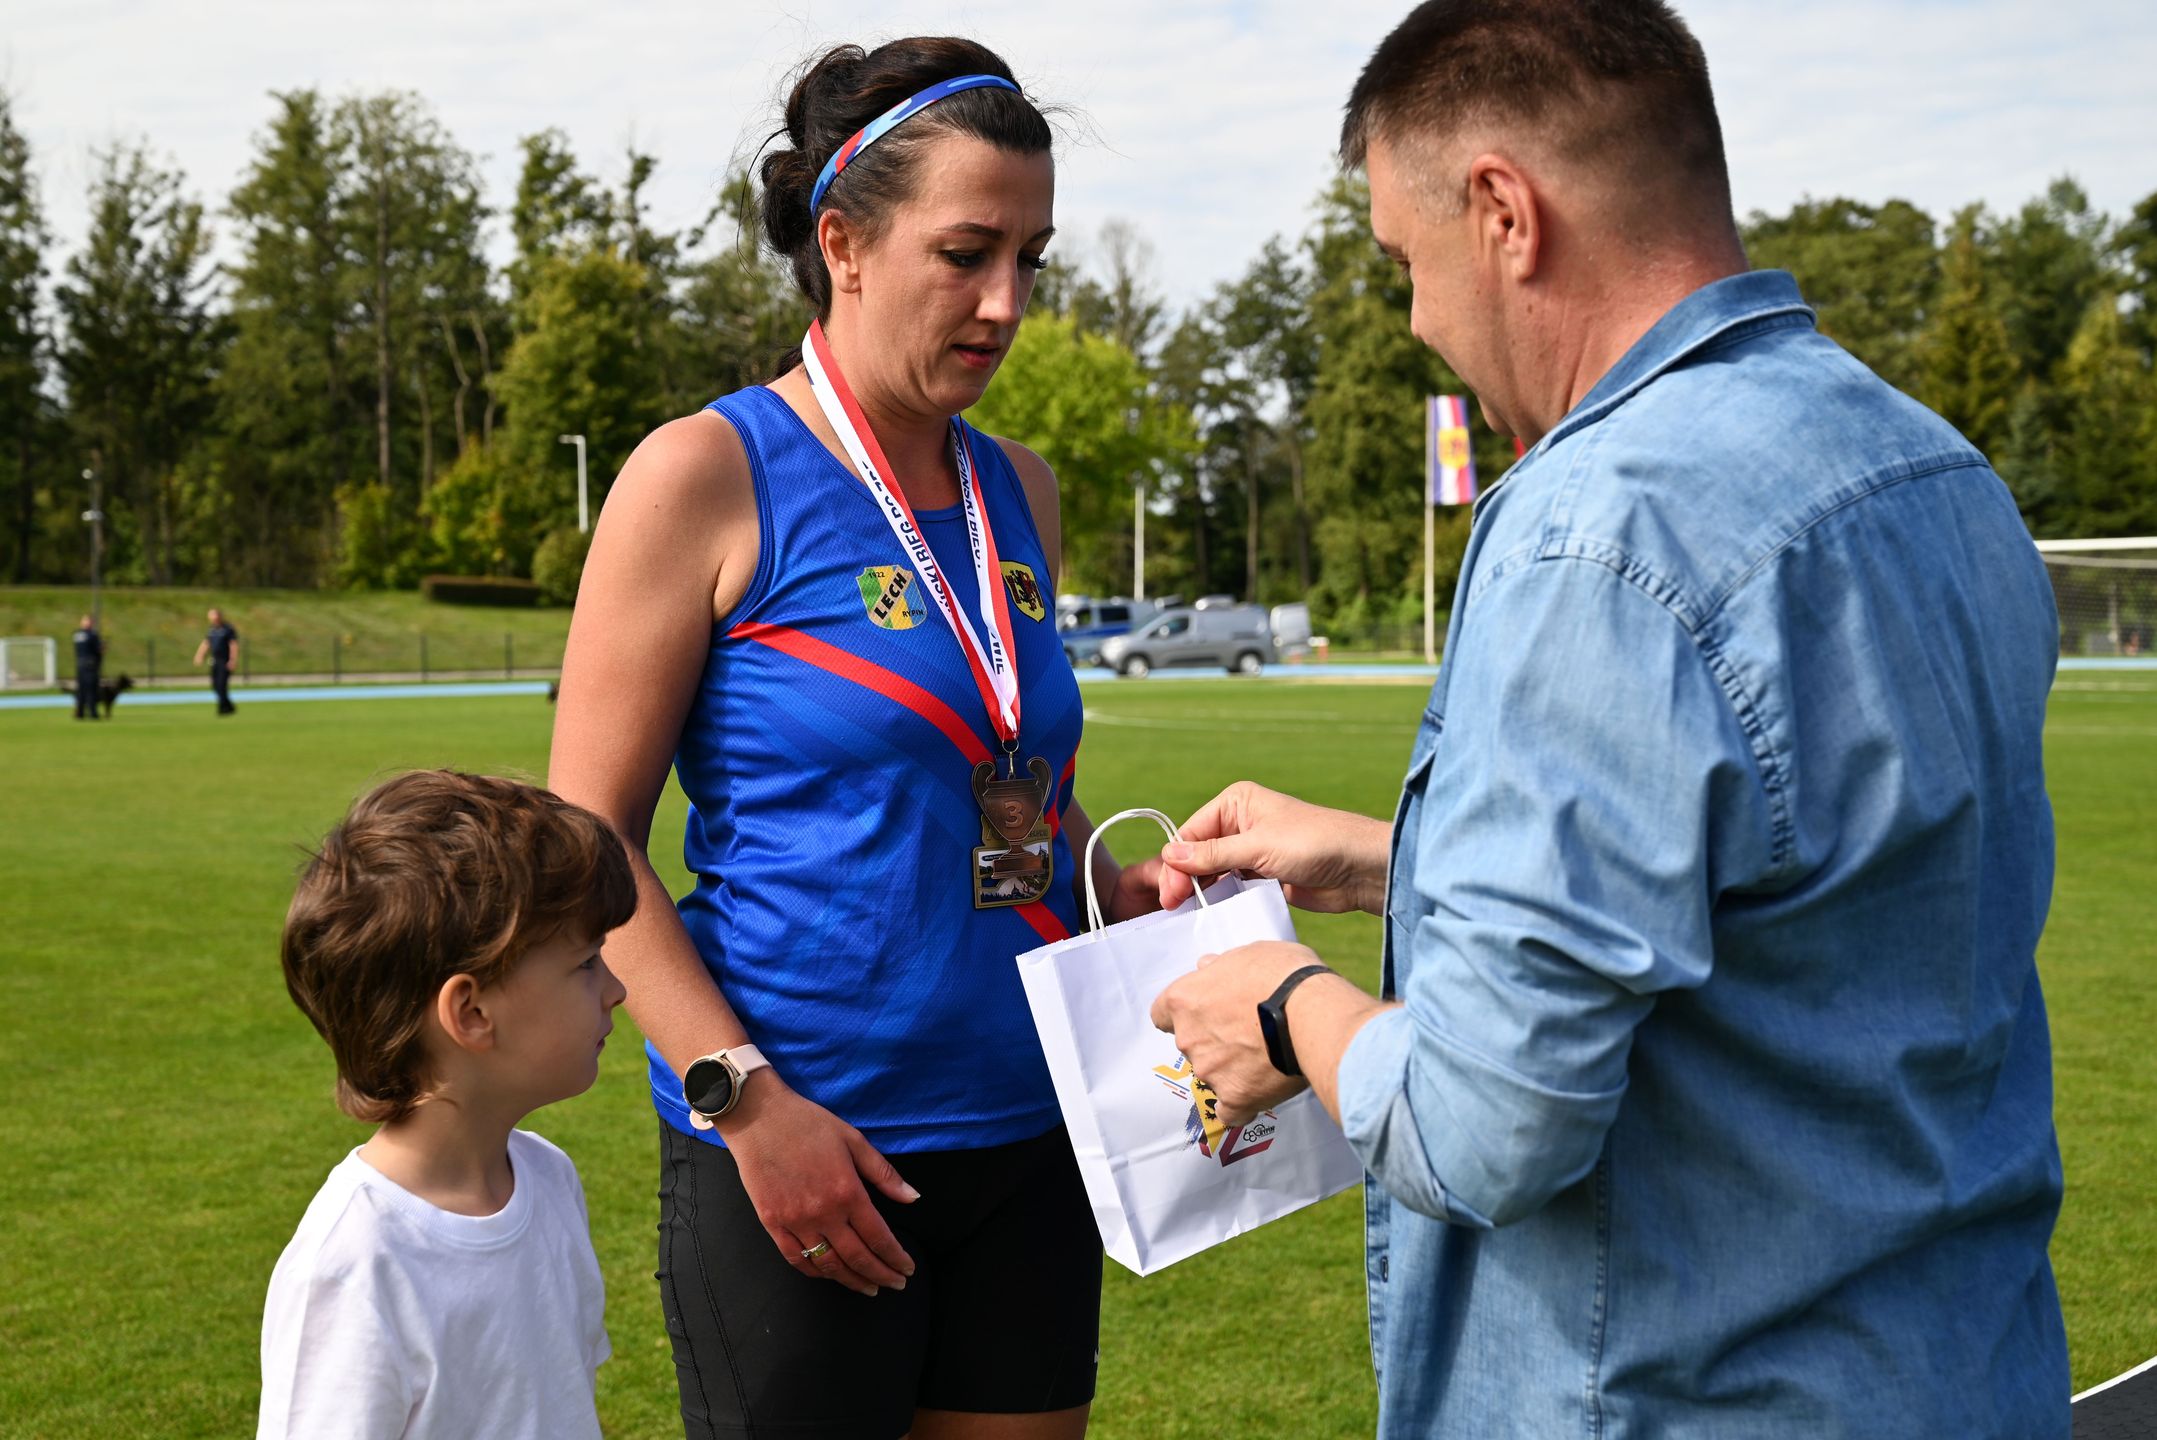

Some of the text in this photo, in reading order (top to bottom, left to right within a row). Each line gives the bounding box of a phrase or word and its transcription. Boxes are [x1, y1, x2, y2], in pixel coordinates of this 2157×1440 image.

[900, 521, 930, 562] BIEG
[873, 571, 908, 620] LECH
[902, 609, 924, 618] RYPIN
[1004, 801, 1024, 828] 3
